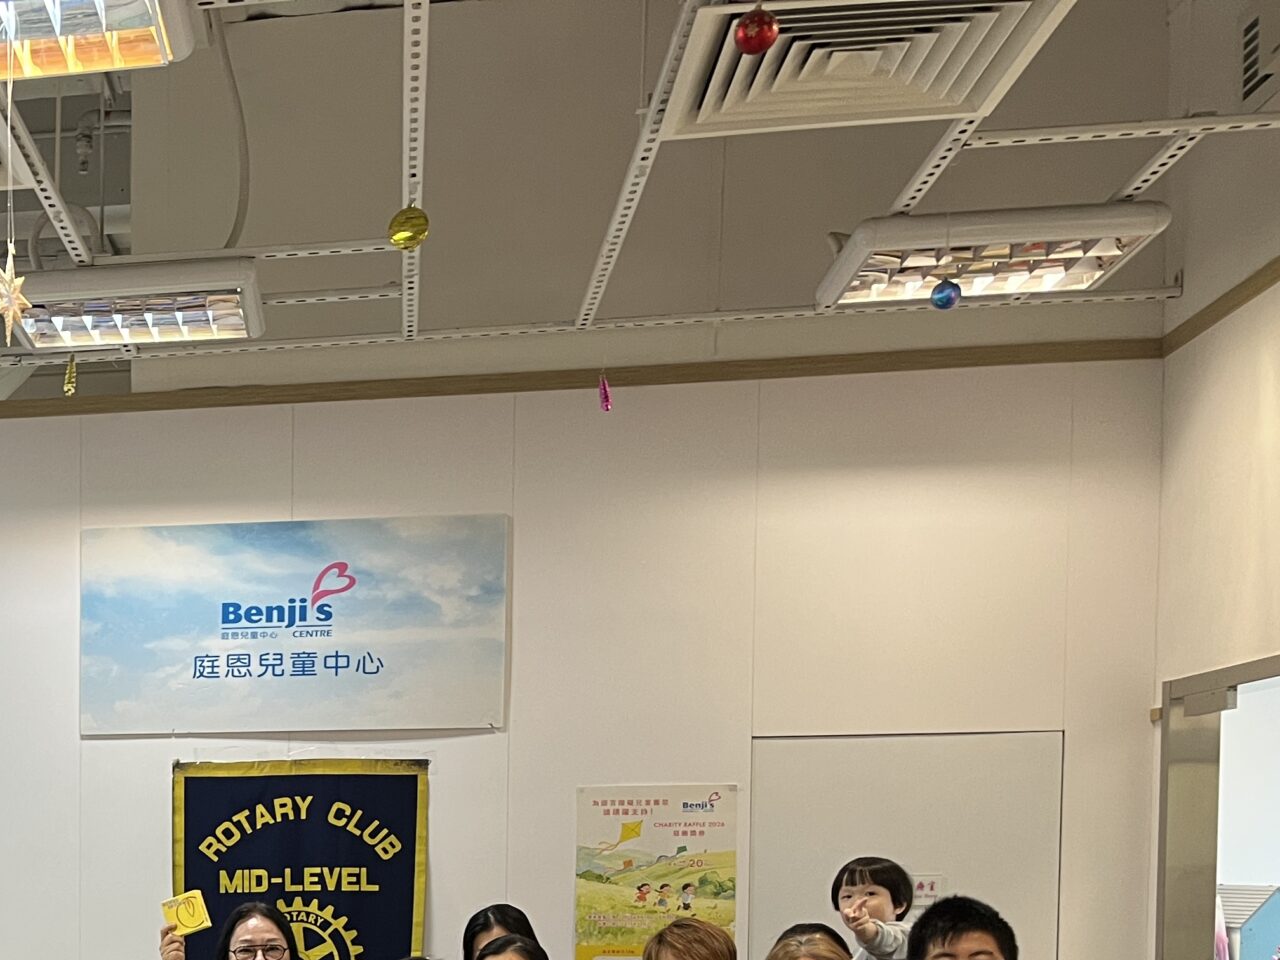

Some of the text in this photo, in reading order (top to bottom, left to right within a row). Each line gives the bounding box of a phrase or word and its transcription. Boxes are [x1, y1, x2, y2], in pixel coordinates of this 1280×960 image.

[221, 597, 333, 629] Benji's
[221, 631, 278, 640] 庭恩兒童中心
[292, 629, 333, 638] CENTRE
[192, 649, 385, 680] 庭恩兒童中心
[198, 795, 403, 862] ROTARY CLUB
[219, 867, 380, 894] MID-LEVEL
[284, 912, 325, 926] OTARY
